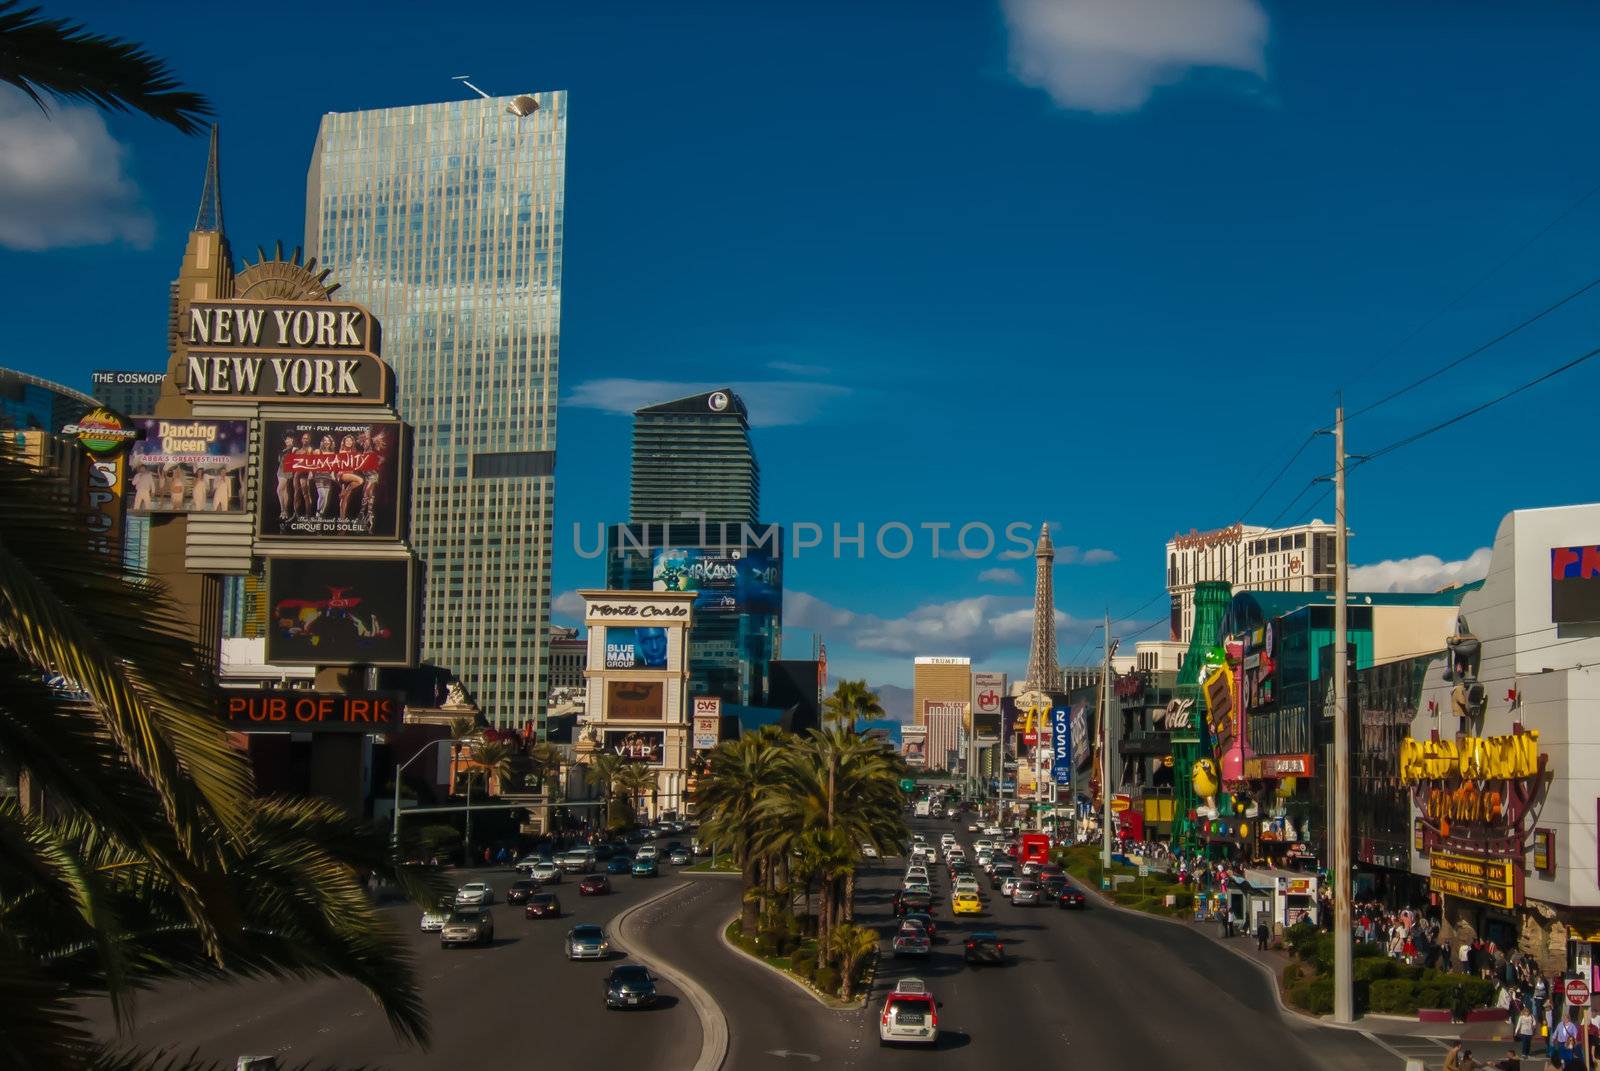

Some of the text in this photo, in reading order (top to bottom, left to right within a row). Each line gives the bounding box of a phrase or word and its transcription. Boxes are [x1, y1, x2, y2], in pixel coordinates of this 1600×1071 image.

[189, 308, 361, 346] NEW YORK
[92, 373, 113, 383] THE
[187, 356, 360, 395] NEW YORK
[158, 421, 217, 441] Dancing
[161, 439, 207, 454] Queen
[292, 453, 369, 471] ZUMANITY
[291, 523, 320, 532] CIRQUE
[589, 604, 688, 618] Monte Carlo
[607, 644, 635, 653] BLUE
[607, 652, 635, 661] MAN
[229, 697, 289, 721] PUB
[294, 699, 334, 722] OF
[697, 701, 717, 711] CVS
[1056, 710, 1067, 758] ROSS
